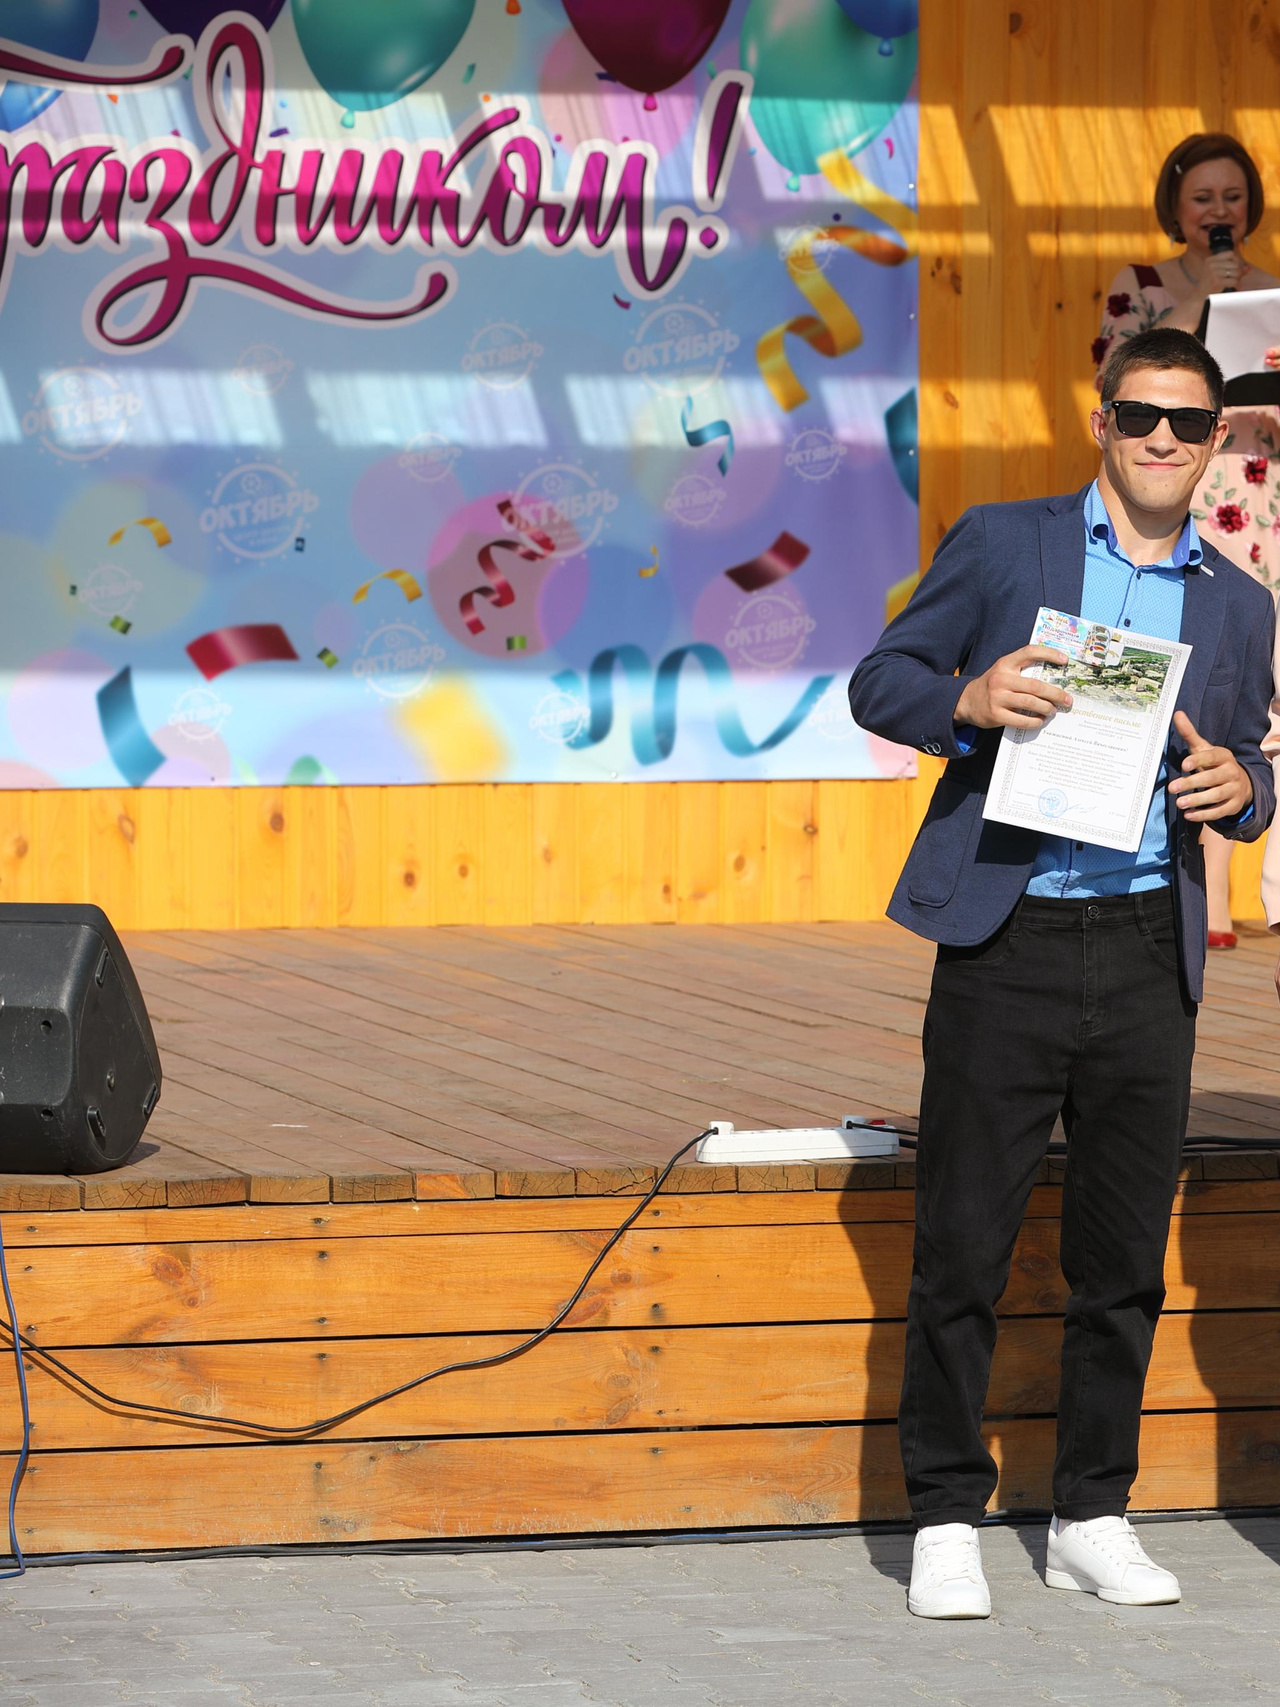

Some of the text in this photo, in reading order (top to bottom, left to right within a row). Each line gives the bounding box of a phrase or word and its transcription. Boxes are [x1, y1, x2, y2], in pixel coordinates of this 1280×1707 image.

[0, 22, 746, 346] раздником!
[462, 341, 545, 371] ОКТЯБРЬ
[623, 328, 741, 372] ОКТЯБРЬ
[22, 390, 143, 435] ОКТЯБРЬ
[784, 442, 848, 466] ОКТЯБРЬ
[199, 489, 320, 533] ОКТЯБРЬ
[501, 488, 619, 532] ОКТЯБРЬ
[724, 614, 817, 648] ОКТЯБРЬ
[352, 643, 446, 678] ОКТЯБРЬ
